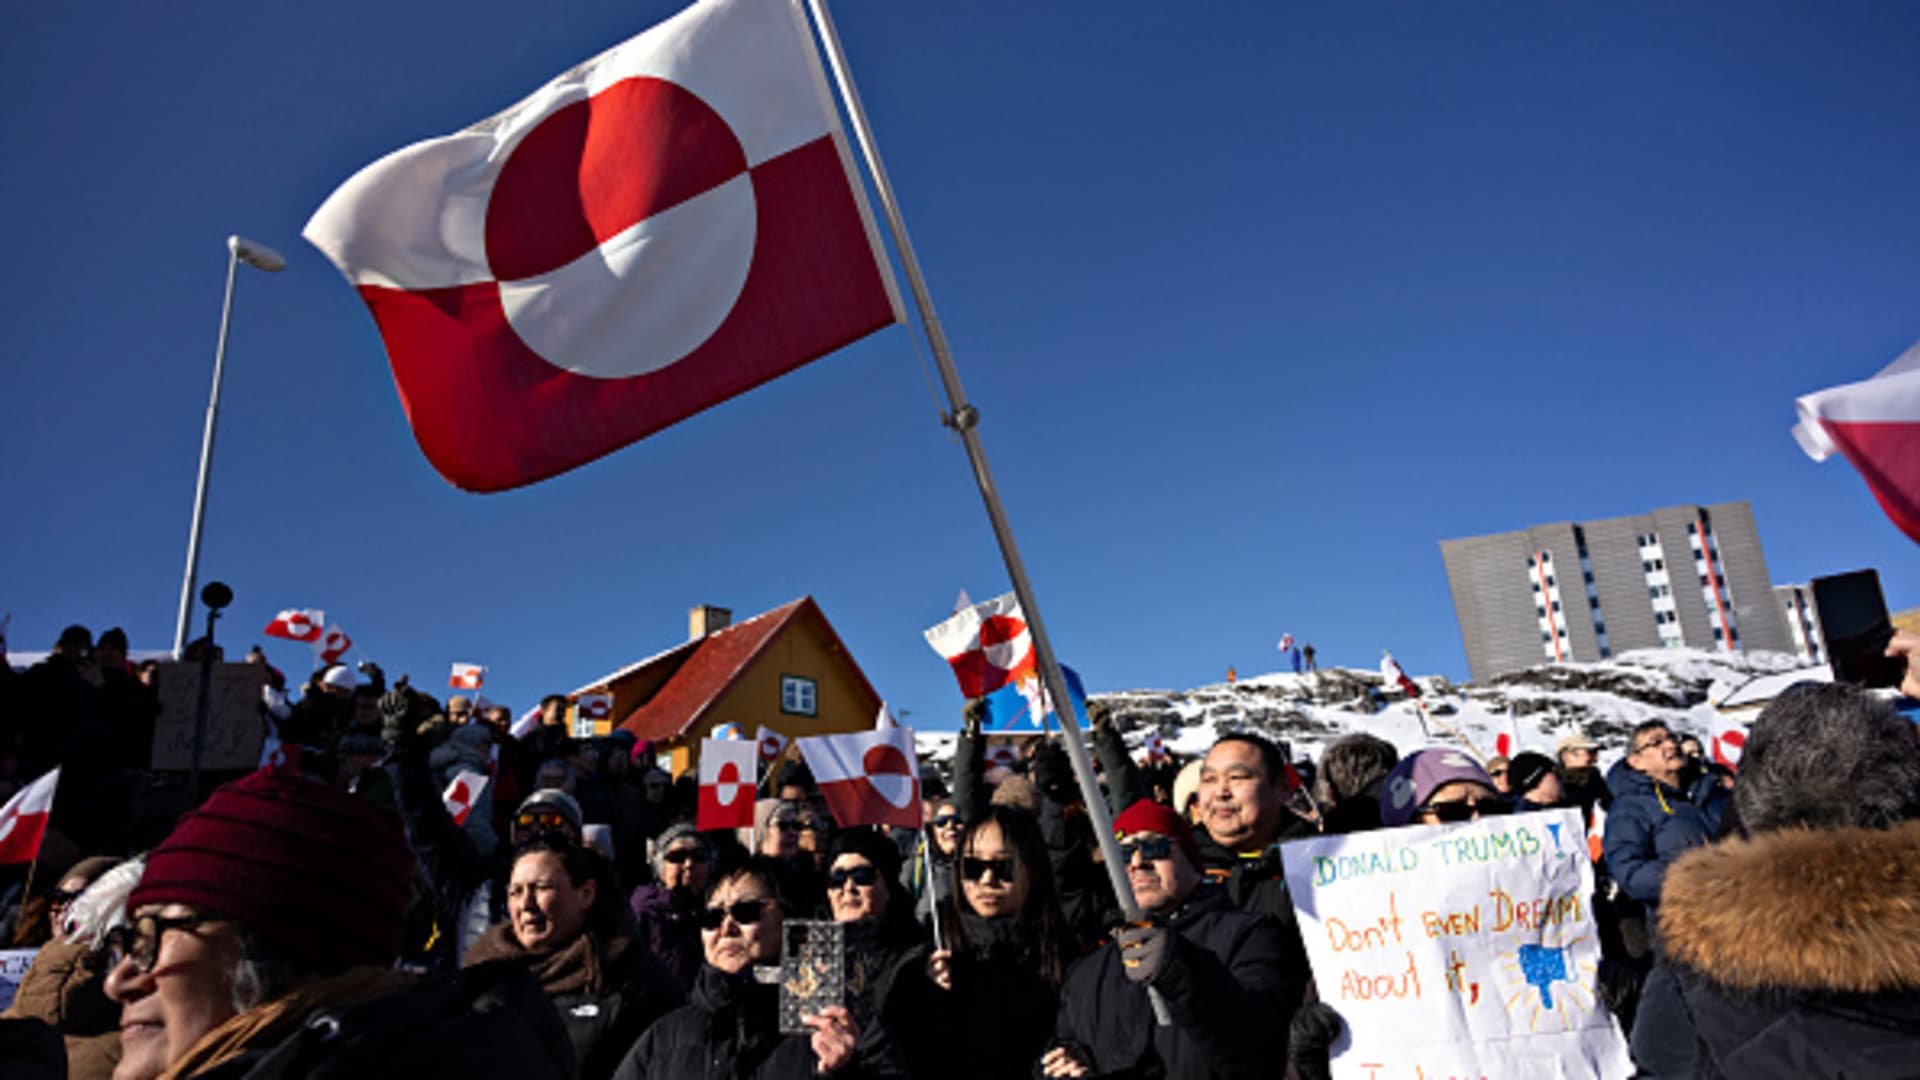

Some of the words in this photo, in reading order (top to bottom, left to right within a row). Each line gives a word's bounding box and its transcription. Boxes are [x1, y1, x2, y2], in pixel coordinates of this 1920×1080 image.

[1312, 847, 1419, 887] DONALD
[1326, 891, 1403, 952] Don't
[1422, 905, 1480, 938] EVEN
[1489, 890, 1582, 932] DREAM
